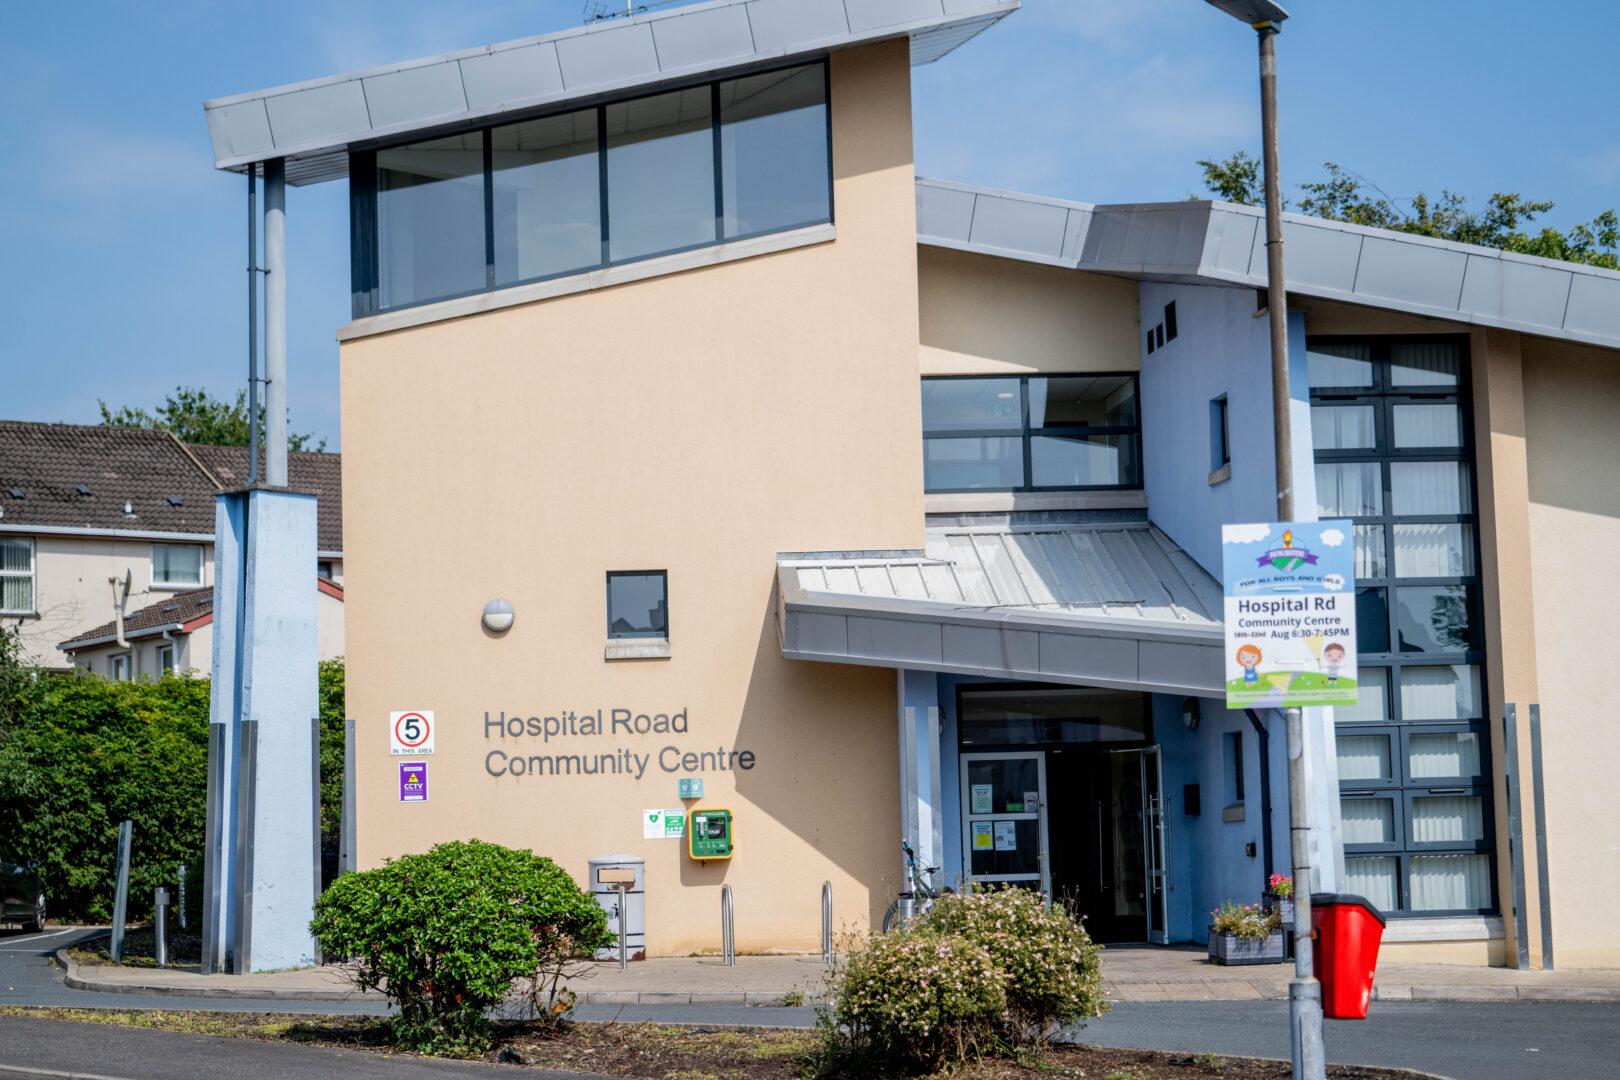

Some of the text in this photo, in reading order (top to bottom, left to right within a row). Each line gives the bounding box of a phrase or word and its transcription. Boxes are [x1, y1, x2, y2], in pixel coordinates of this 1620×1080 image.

[1269, 549, 1305, 559] PATHLIGHTERS
[1316, 576, 1341, 585] GIRLS
[1238, 596, 1336, 616] Hospital Rd
[1238, 616, 1341, 628] Community Centre
[1271, 630, 1289, 640] Aug
[1291, 628, 1349, 638] 6:30-7:45PM
[405, 718, 420, 740] 5
[484, 707, 688, 743] Hospital Road
[485, 745, 756, 780] Community Centre
